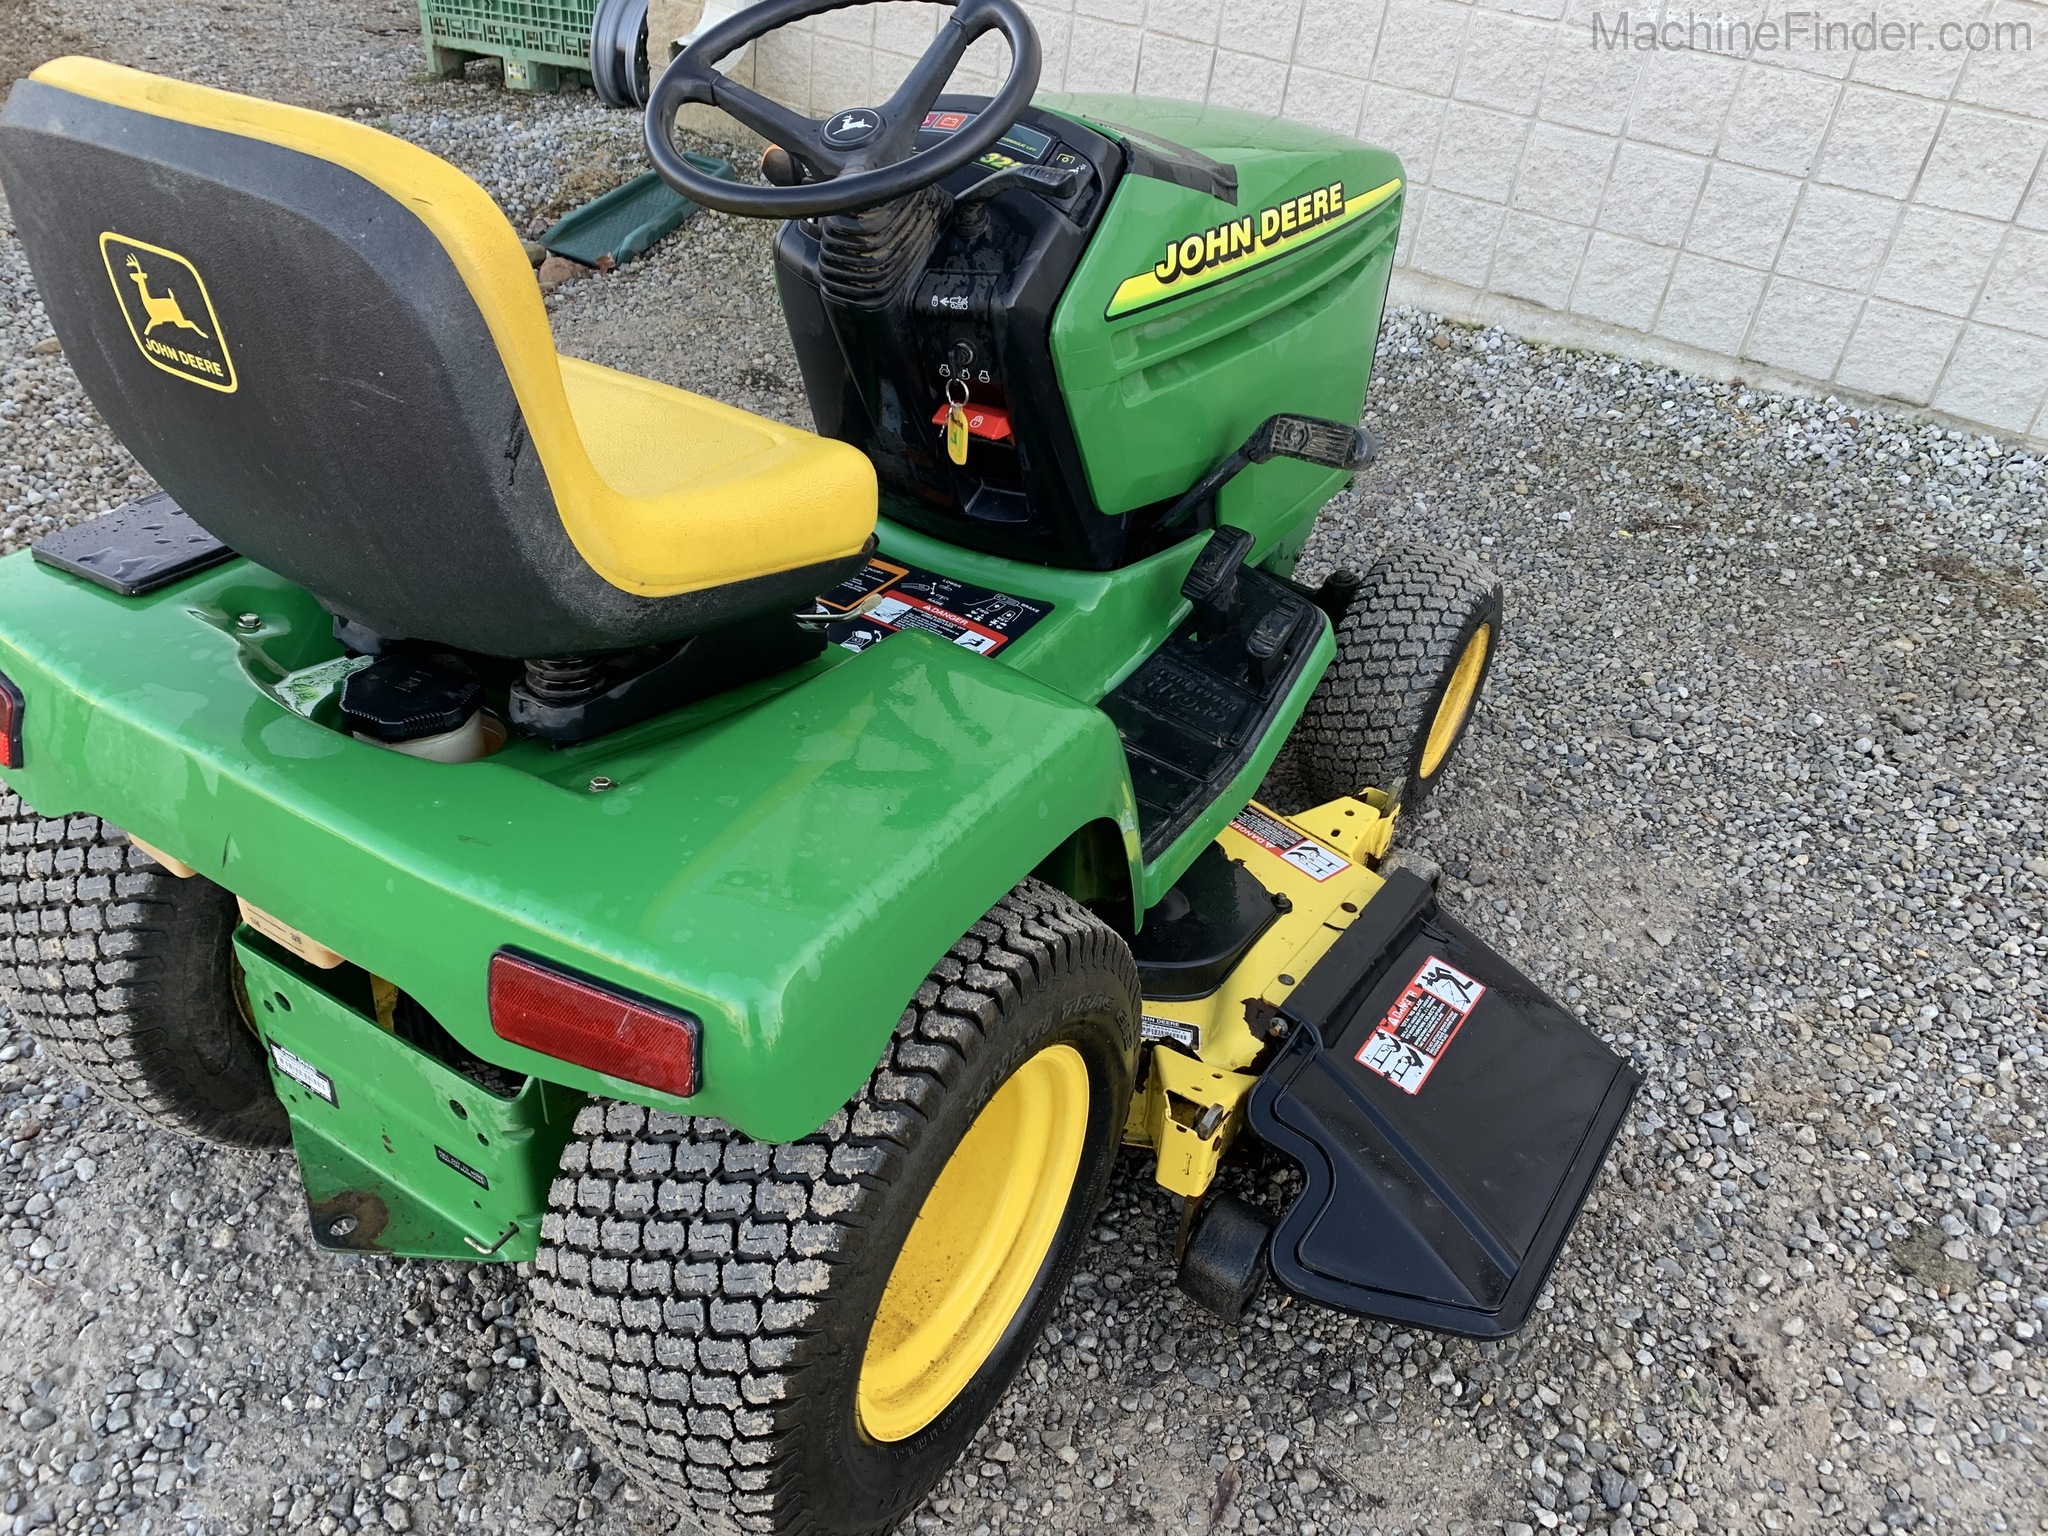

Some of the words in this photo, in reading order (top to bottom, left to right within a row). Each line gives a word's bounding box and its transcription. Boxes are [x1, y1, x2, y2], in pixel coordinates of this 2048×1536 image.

[980, 152, 1024, 170] 32
[1154, 214, 1254, 283] JOHN
[1260, 180, 1344, 246] DEERE
[145, 337, 179, 361] JOHN
[178, 350, 224, 377] DEERE
[942, 579, 962, 589] LOWER
[930, 607, 969, 626] DANGER
[1020, 603, 1040, 614] BRAKE
